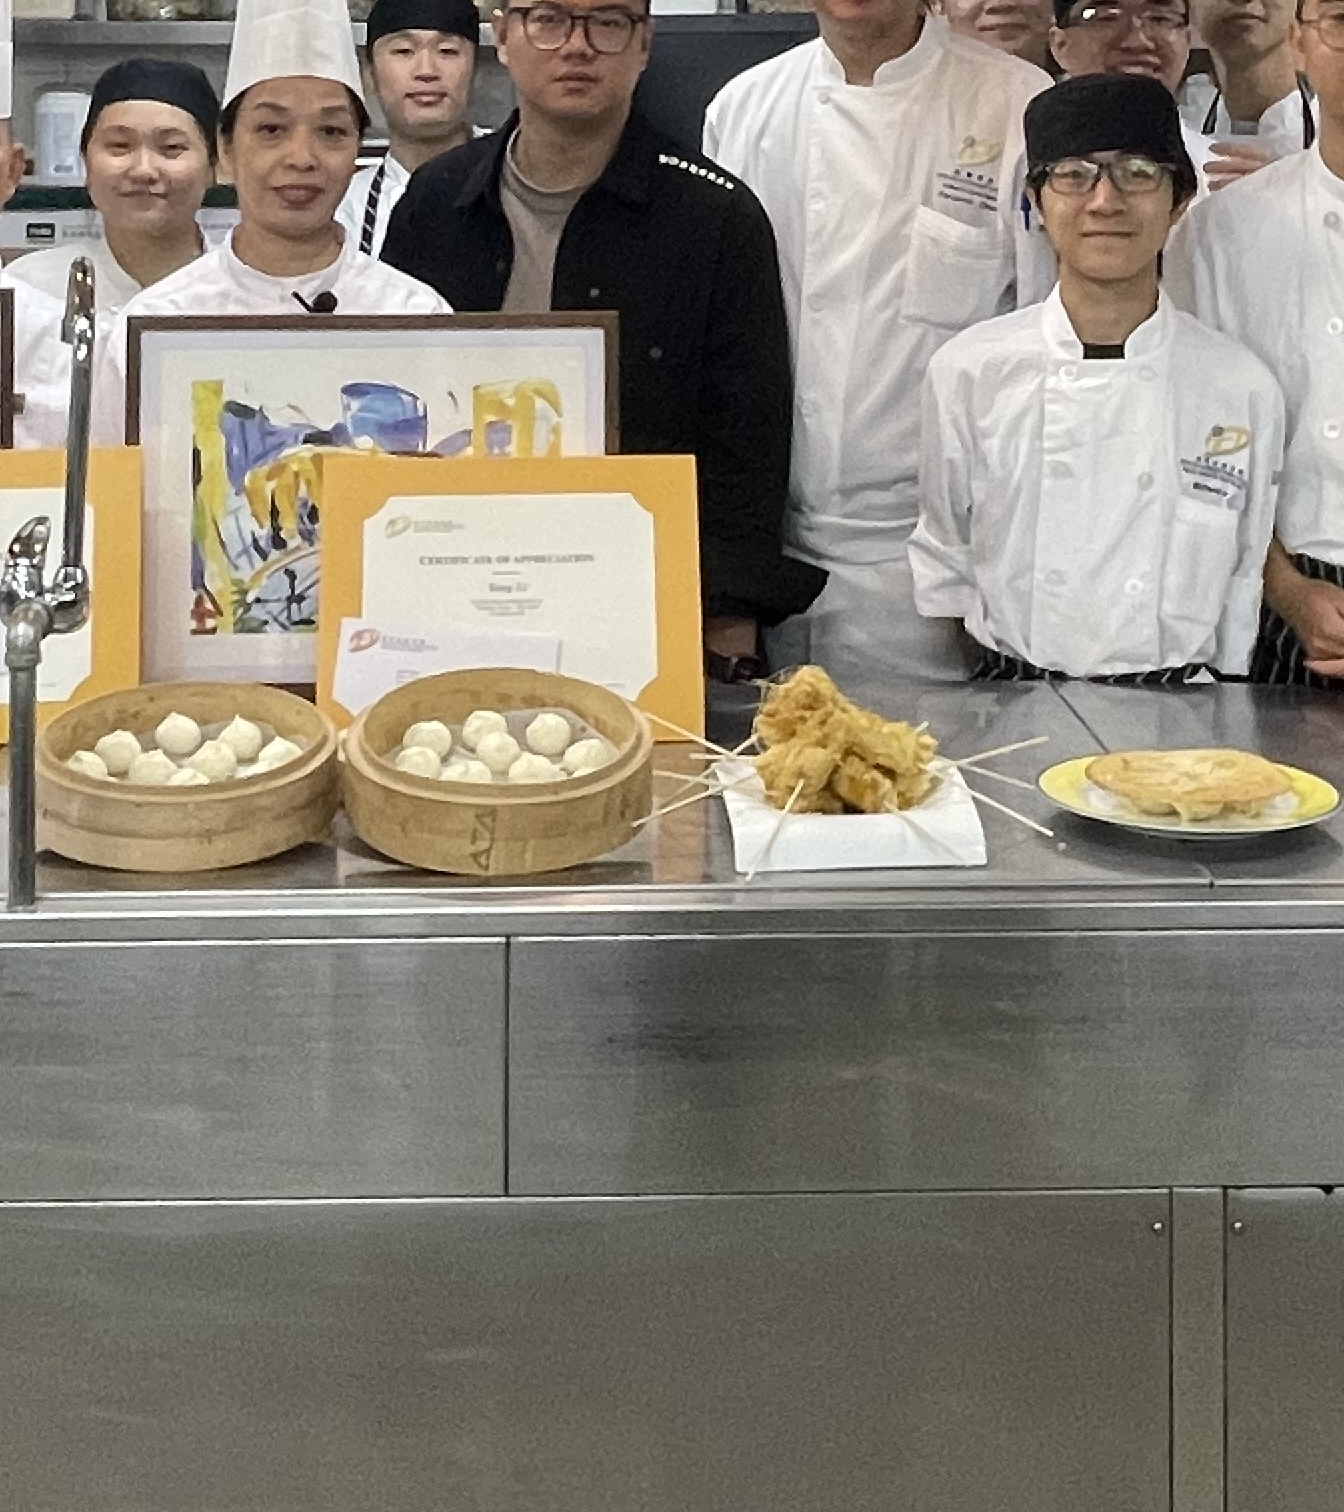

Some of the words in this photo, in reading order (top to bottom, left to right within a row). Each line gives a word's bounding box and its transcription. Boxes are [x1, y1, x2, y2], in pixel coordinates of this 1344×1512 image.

[418, 555, 492, 566] CERTIFICATE
[495, 554, 510, 564] OF
[514, 553, 594, 564] APPRECIATION
